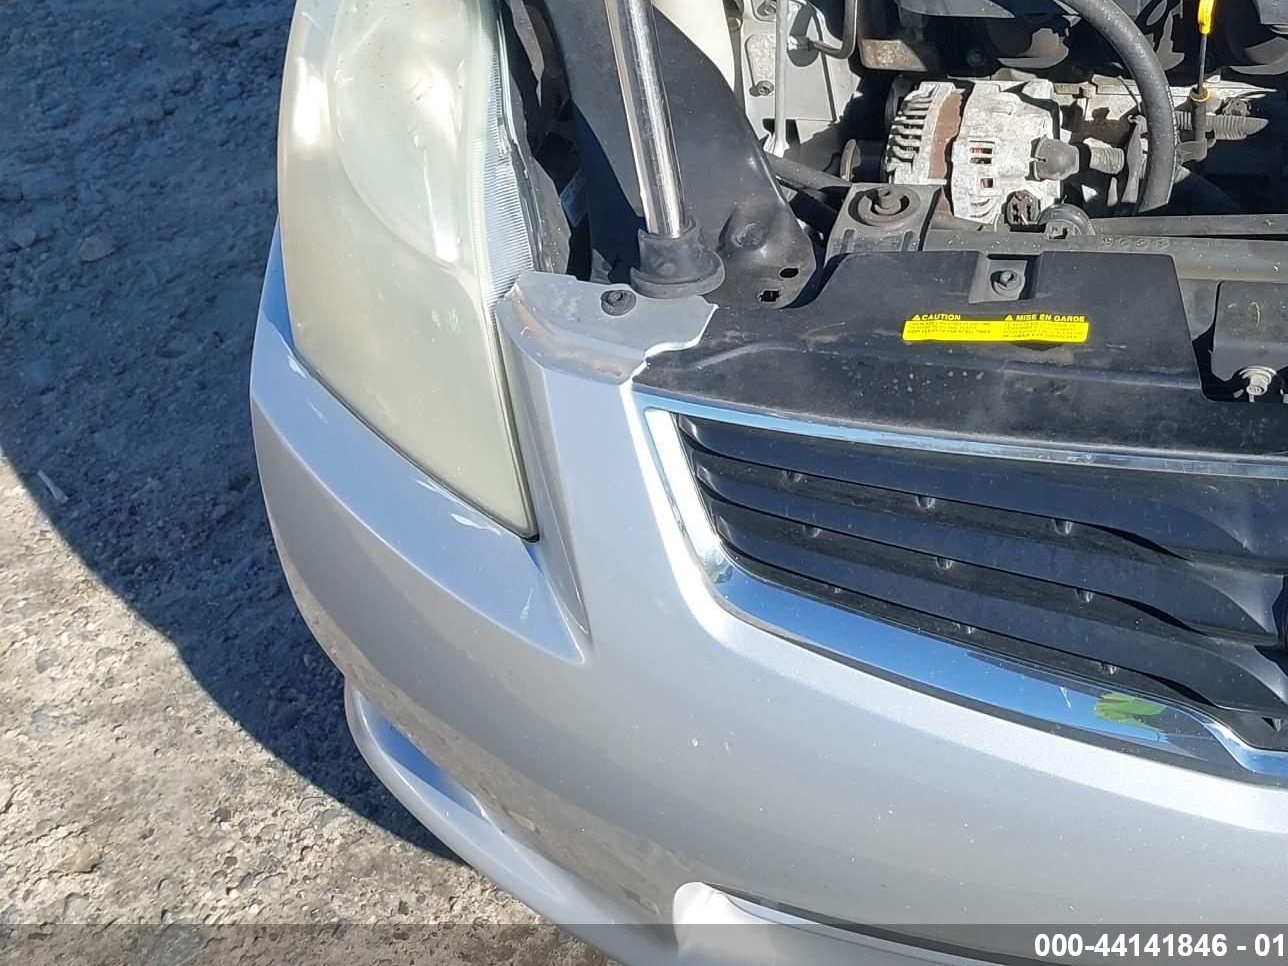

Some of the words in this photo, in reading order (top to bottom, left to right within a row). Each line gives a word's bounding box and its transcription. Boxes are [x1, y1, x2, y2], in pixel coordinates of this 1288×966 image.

[921, 313, 961, 321] CAUTION
[1016, 313, 1037, 321] MISE
[1039, 313, 1052, 321] EN
[1054, 314, 1085, 322] GARDE
